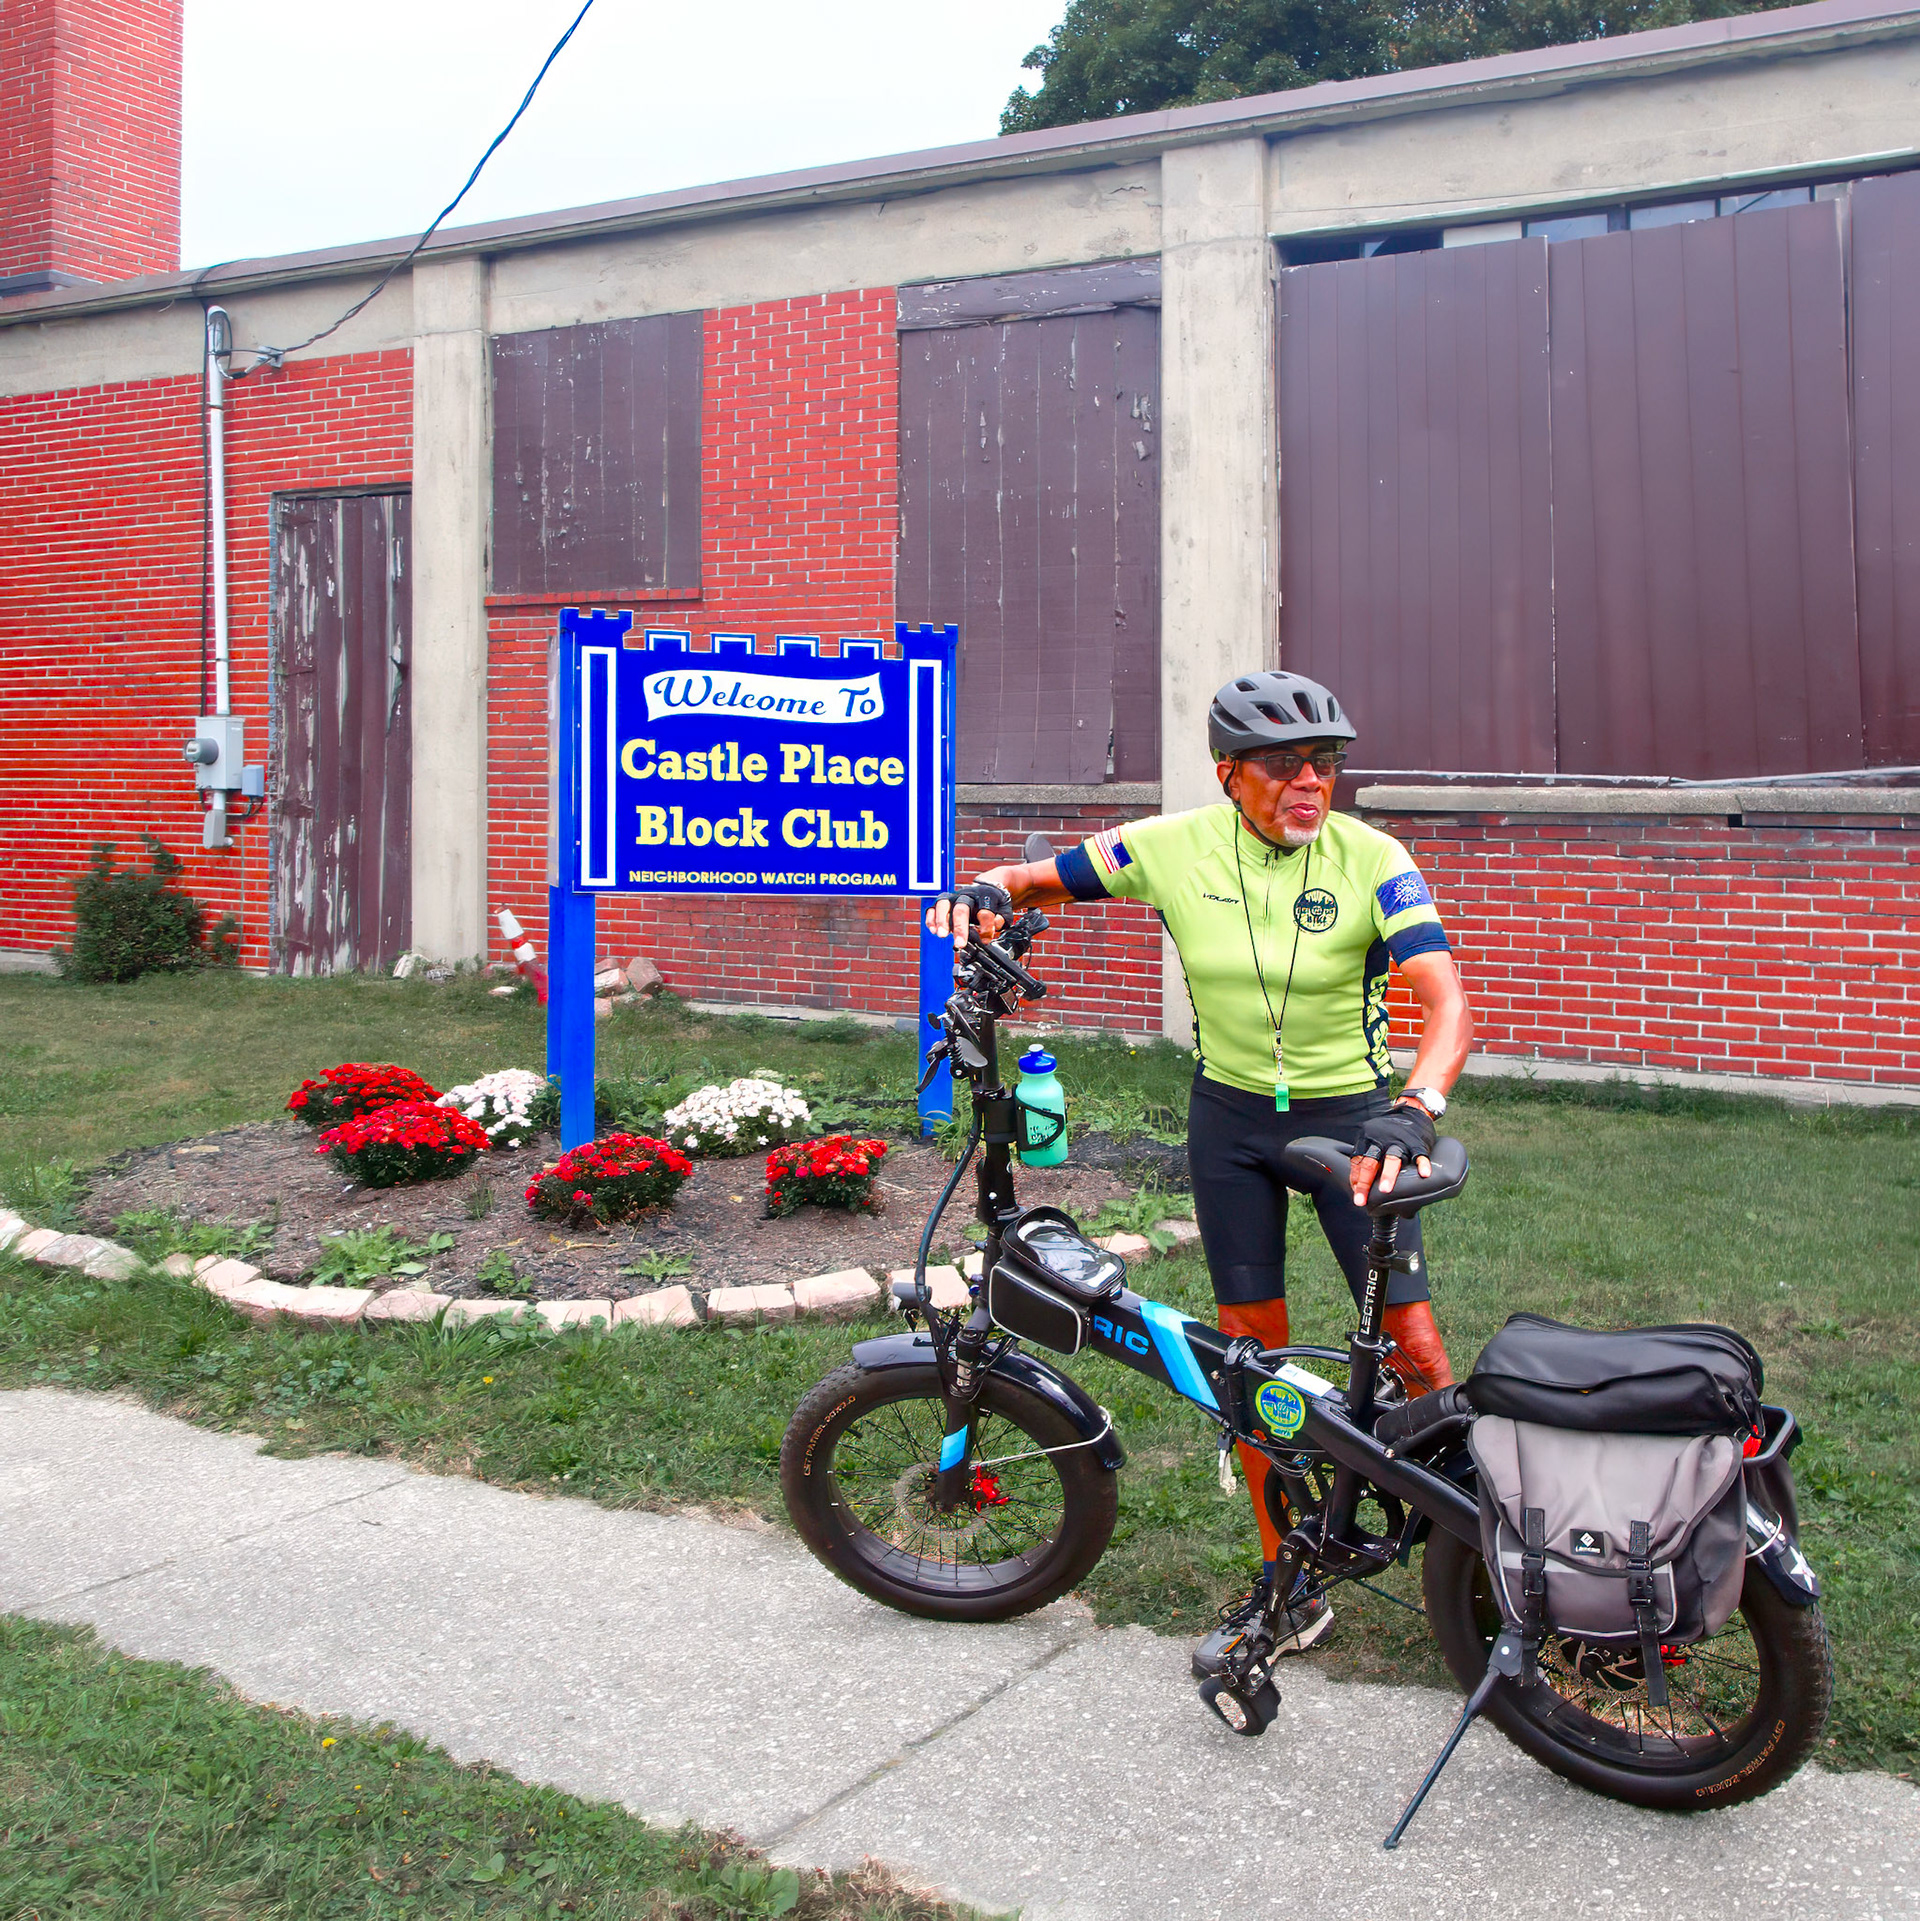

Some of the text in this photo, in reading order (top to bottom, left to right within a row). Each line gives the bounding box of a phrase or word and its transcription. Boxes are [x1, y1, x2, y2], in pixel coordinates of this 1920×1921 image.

[653, 675, 877, 718] Welcome To
[621, 739, 904, 785] Castle Place
[636, 806, 888, 849] Block Club
[629, 871, 896, 885] NEIGHBORHOOD WATCH PROGRAM
[1360, 1269, 1378, 1335] LECTRIC
